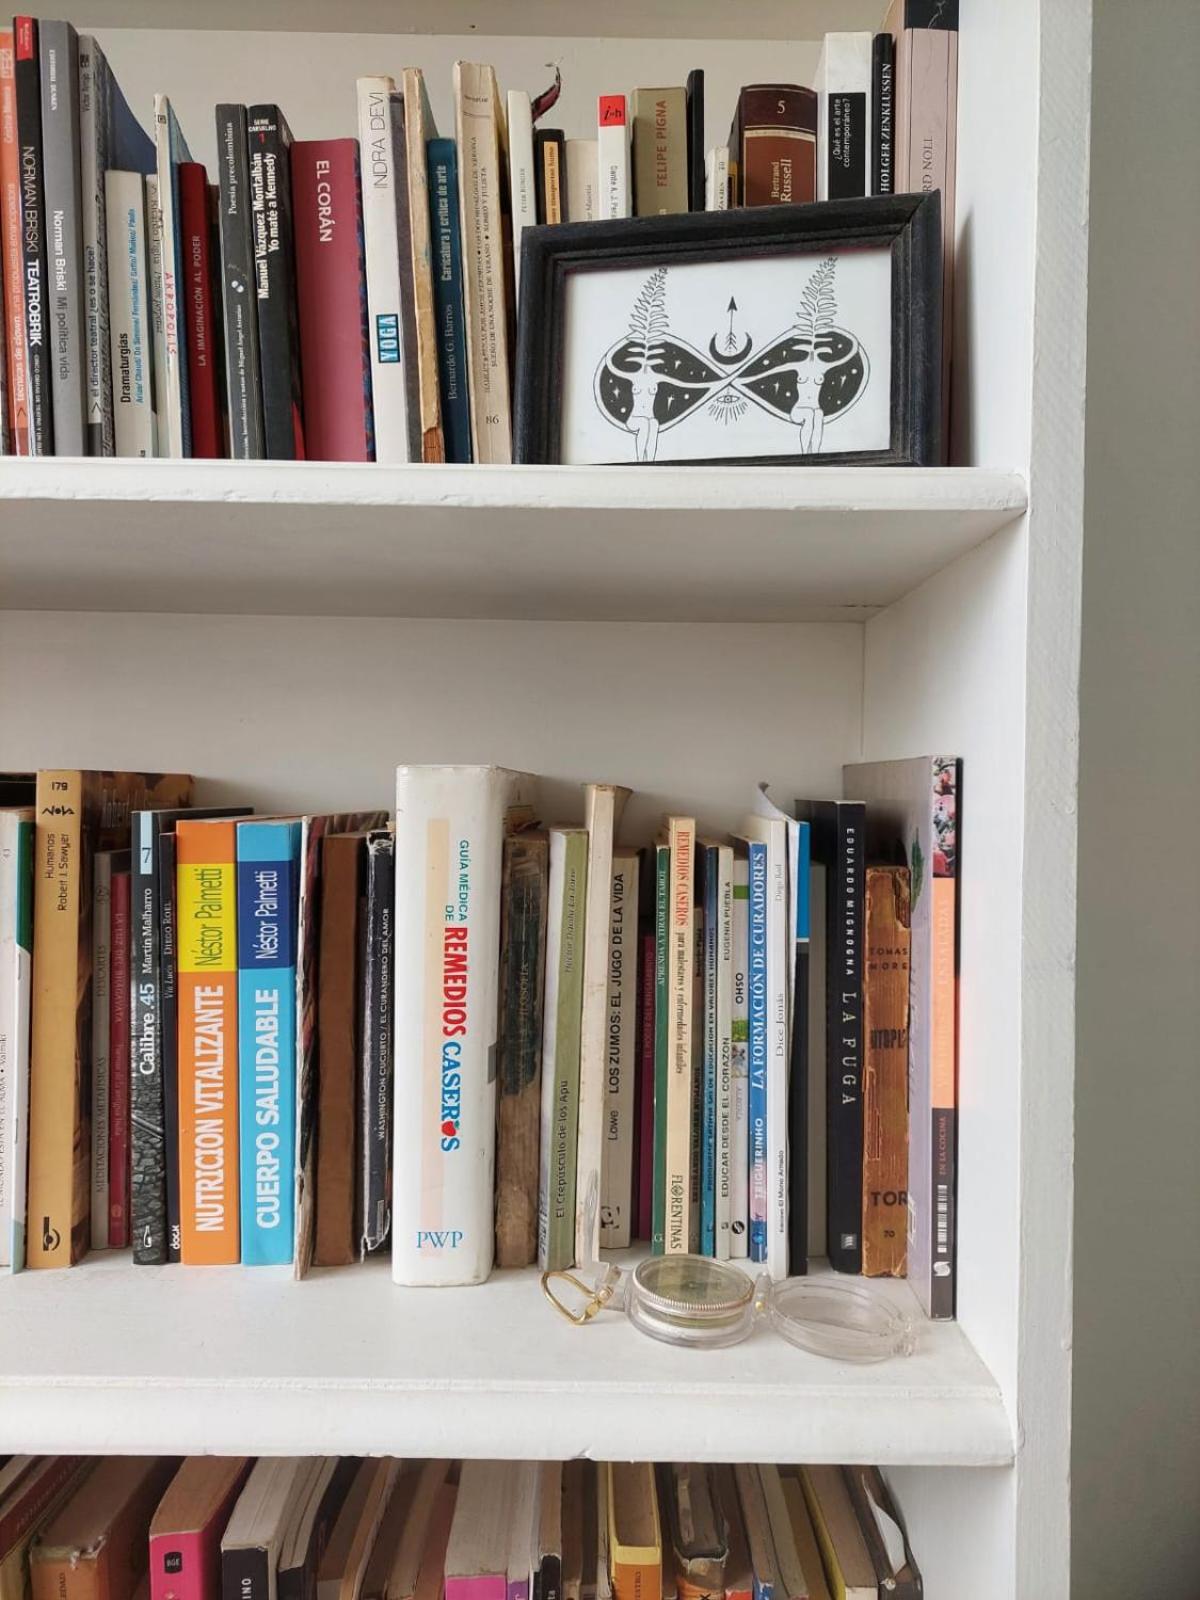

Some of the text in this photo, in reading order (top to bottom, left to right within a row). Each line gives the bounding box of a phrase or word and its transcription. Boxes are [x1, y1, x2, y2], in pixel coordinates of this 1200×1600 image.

[777, 100, 786, 115] 5
[832, 98, 843, 160] ¿Qué es el arte
[880, 63, 892, 192] HOLGER ZENKLUSSEN
[224, 122, 237, 185] precolombina
[368, 92, 388, 190] INDRA DEVI
[655, 100, 668, 187] FELIPE PIGNA
[842, 98, 853, 168] contemporáneo?
[922, 135, 934, 170] NOLL
[264, 152, 278, 200] Kennedy
[435, 165, 447, 184] arte
[436, 185, 448, 196] de
[770, 161, 780, 199] Bertrand
[779, 158, 793, 203] Russell
[252, 152, 270, 299] Manuel Vázquez Montalbán
[266, 211, 279, 238] maté
[315, 160, 335, 243] EL CORÁN
[438, 198, 449, 227] crítica
[22, 146, 42, 347] NORMAN BRISKI TEATROBRIK
[85, 245, 97, 273] hace?
[267, 239, 280, 253] Yo
[440, 235, 452, 281] Caricatura
[53, 210, 71, 381] Norman Briski Mi política vida
[87, 274, 97, 287] se
[191, 235, 206, 367] LA IMAGINACIÓN AL PODER
[88, 315, 98, 347] teatral
[378, 314, 399, 362] YOGA
[443, 304, 458, 400] Bernardo G. Barros
[89, 349, 99, 387] director
[117, 332, 133, 404] Dramaturgias
[51, 781, 69, 792] 179
[45, 833, 56, 879] Humanos
[57, 833, 71, 911] Robert Sawyer
[142, 847, 152, 864] 7
[676, 831, 691, 881] REMEDIOS
[458, 839, 472, 922] GUÍA MÉDICA
[190, 868, 224, 966] Néstor Palmetti
[252, 870, 279, 959] Néstor Palmetti
[445, 904, 455, 922] DE
[657, 911, 666, 937] TIRAR
[675, 883, 690, 927] CASEROS
[162, 926, 173, 956] DIEGO
[675, 931, 687, 948] para
[869, 947, 909, 957] TOMAS
[95, 945, 107, 998] DESCARTES
[138, 888, 156, 1076] Calibre .45 Malharro
[442, 926, 469, 1037] REMEDIOS
[657, 945, 666, 987] APRENDA
[677, 949, 688, 986] malestares
[841, 828, 857, 1105] EDUARDO MIGNOGNA LA FUGA
[868, 961, 908, 971] MORE
[378, 908, 390, 1141] WASHINGTON CUCURTO EL CURANDERO DEL AMOR
[607, 873, 625, 1141] Lowe LOS ZUMOS: EL JUGO DE LA VIDA
[676, 993, 688, 1041] enfermedades
[749, 853, 765, 1198] TRIGUERINHO LA FORMACIÓN DE CURADORES
[774, 993, 786, 1025] Jonás
[676, 1042, 687, 1074] infantiles
[721, 881, 732, 1198] EDUCAR DESDE EL EUGENIA PUEBLA
[774, 1029, 785, 1057] Dice
[194, 985, 225, 1233] NUTRICION VITALIZANTE
[255, 989, 280, 1230] CUERPO SALUDABLE
[555, 1080, 570, 1219] El de los Apu
[777, 1150, 785, 1177] Armado
[937, 1116, 947, 1176] EN LA COCINA
[870, 1190, 908, 1207] TOR
[416, 1231, 464, 1249] PWP
